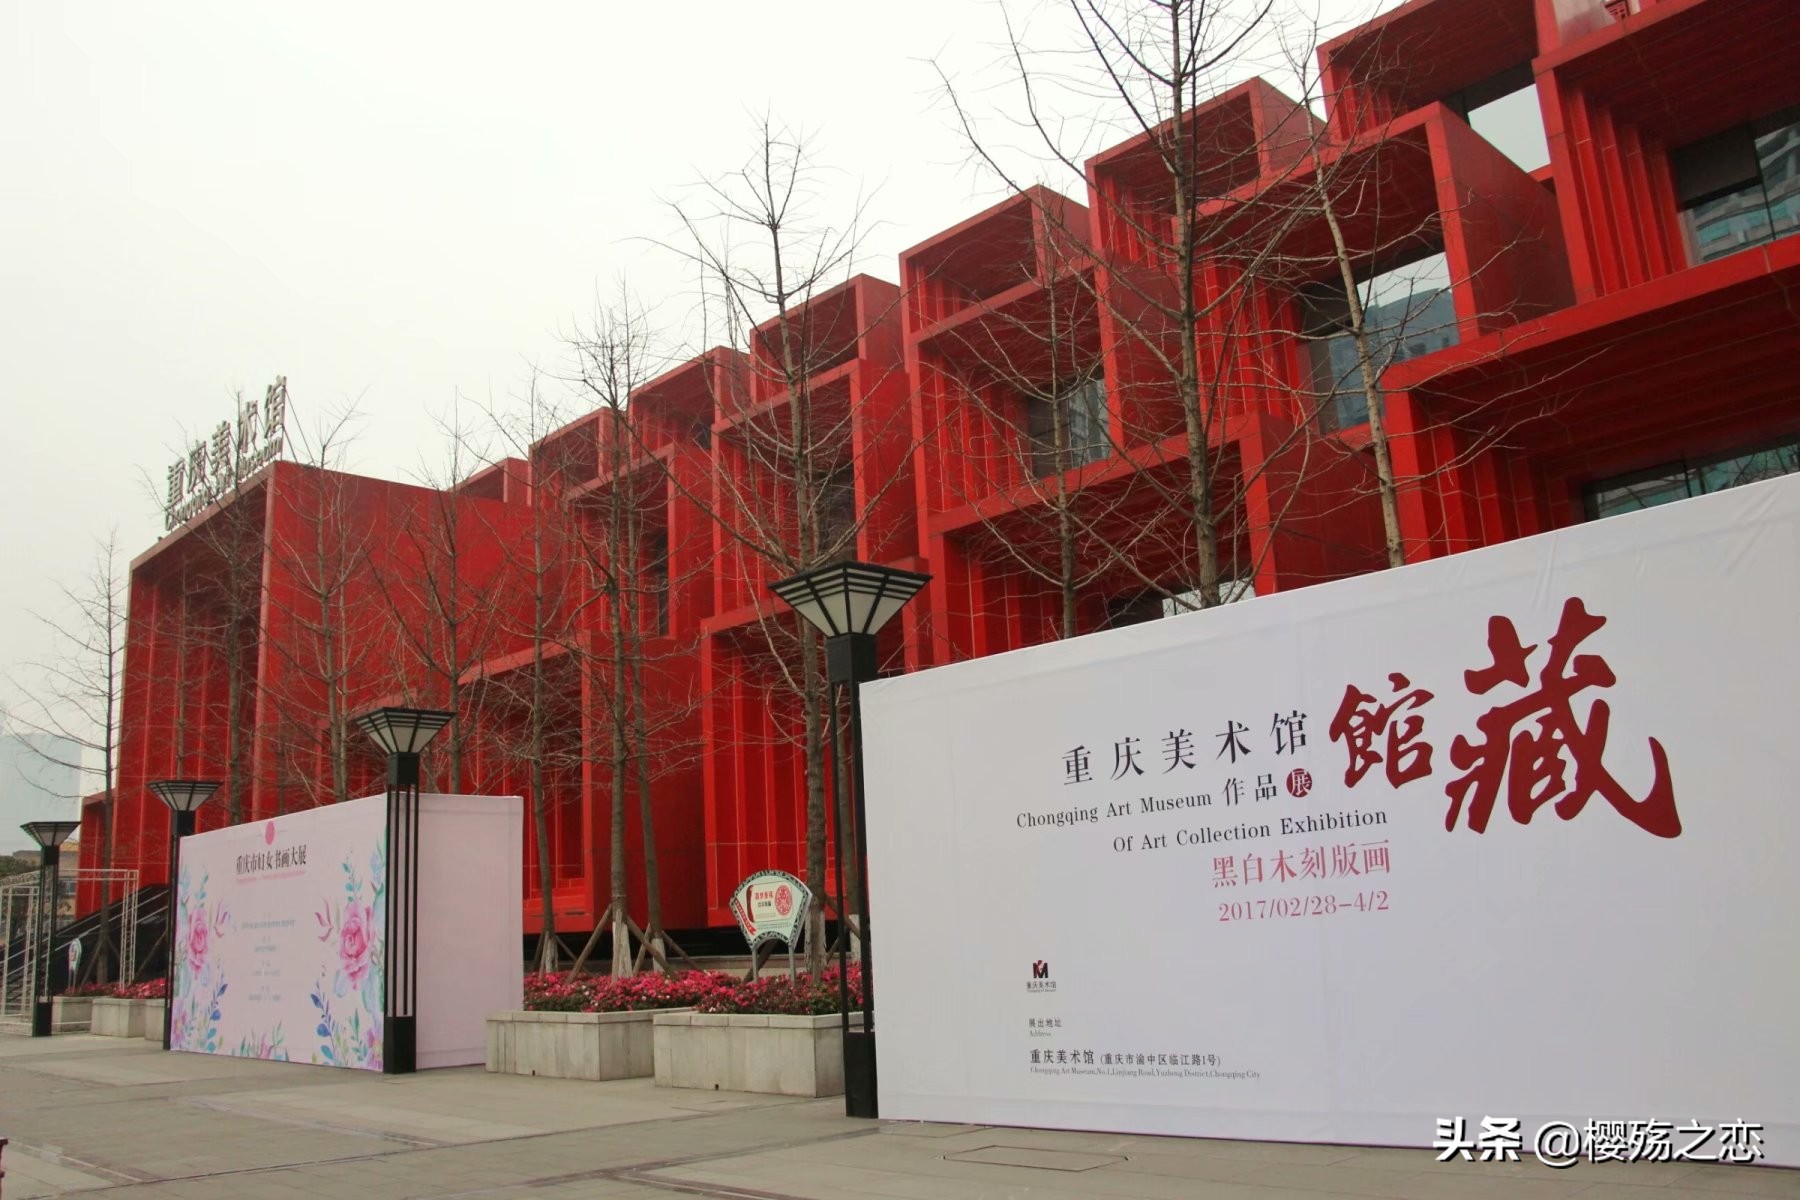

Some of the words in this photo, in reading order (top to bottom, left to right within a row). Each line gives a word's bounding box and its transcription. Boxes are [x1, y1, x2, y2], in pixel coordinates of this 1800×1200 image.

[165, 375, 288, 512] 重庆美术馆
[1062, 710, 1309, 786] 重庆美术馆
[1017, 807, 1098, 828] Chongqing
[1106, 801, 1131, 817] Art
[1140, 794, 1212, 813] Museum
[1113, 836, 1133, 852] Of
[1141, 834, 1167, 850] Art
[1177, 824, 1271, 846] Collection
[1280, 810, 1387, 835] Exhibition
[236, 844, 307, 875] 重庆市妇女书画大展
[1211, 839, 1391, 889] 黑白木刻版画
[1029, 1017, 1062, 1028] 展出地址
[1030, 1048, 1095, 1065] 重庆美术馆
